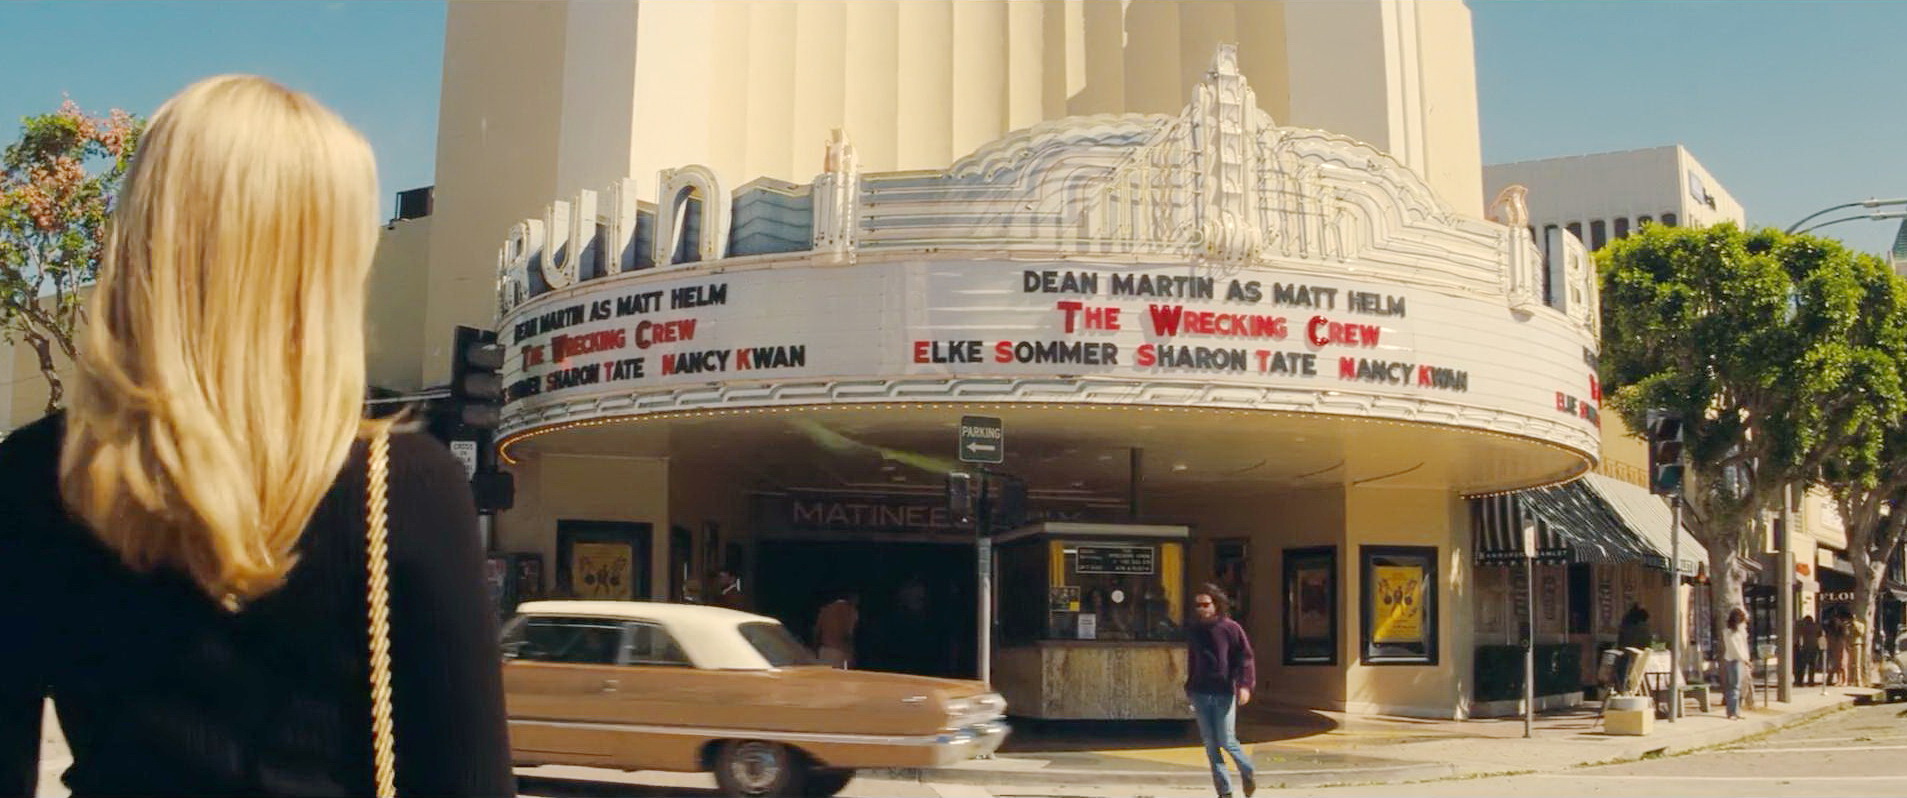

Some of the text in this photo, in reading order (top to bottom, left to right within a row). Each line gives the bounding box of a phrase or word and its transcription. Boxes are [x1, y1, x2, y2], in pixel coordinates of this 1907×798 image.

[496, 164, 732, 318] RUIN
[540, 304, 585, 333] MARTIN
[589, 301, 611, 321] AS
[617, 291, 664, 317] MATT
[671, 284, 728, 309] HELM
[1023, 270, 1406, 318] DEAN MARTIN AS MATT HELM
[551, 328, 626, 363] WRECKING
[635, 319, 697, 350] CREW
[1057, 301, 1381, 348] THE WRECKING CREW
[546, 363, 600, 392] SHARON
[604, 357, 645, 382] TATE
[661, 349, 731, 376] NANCY
[735, 345, 806, 371] KWAN
[914, 341, 1468, 393] ELKE SOMMER SHARON TATE NANCY KWAN
[961, 426, 1001, 439] PARKING
